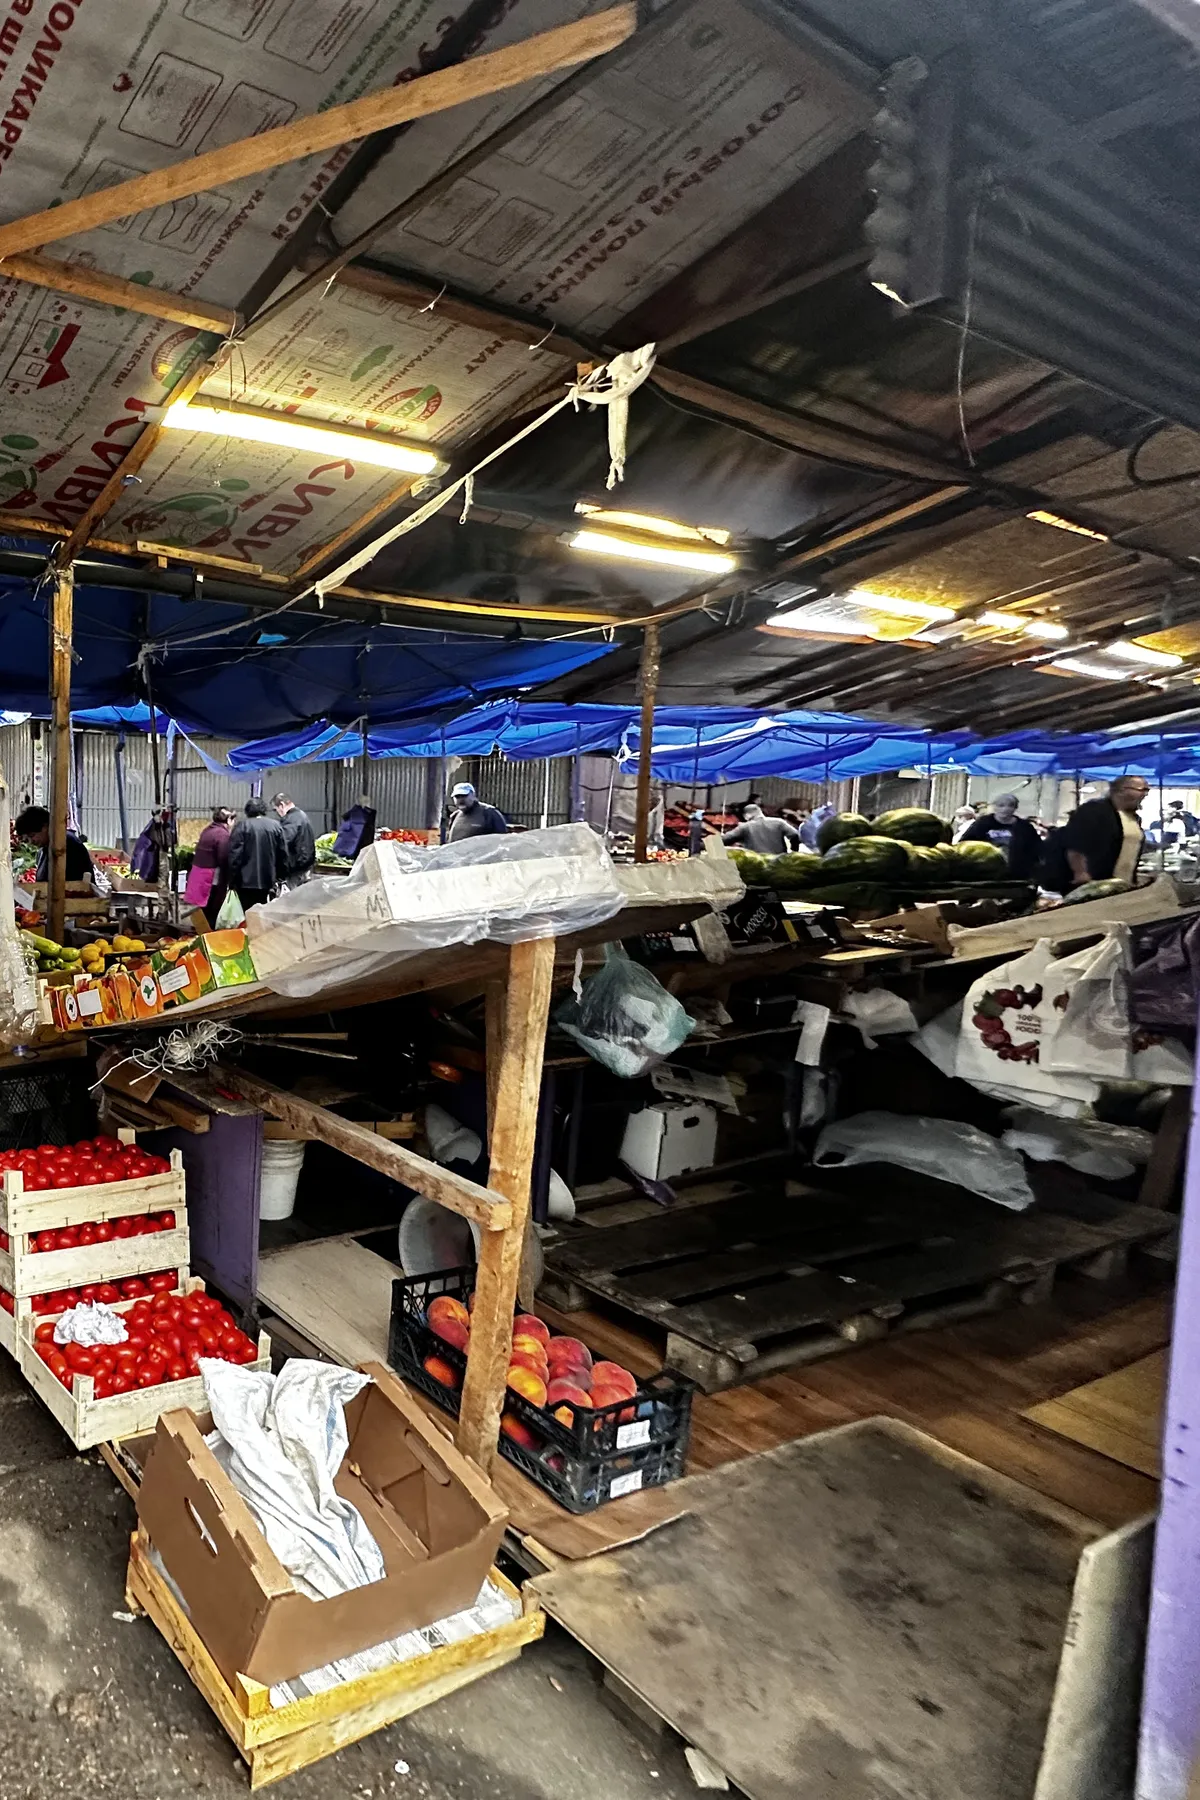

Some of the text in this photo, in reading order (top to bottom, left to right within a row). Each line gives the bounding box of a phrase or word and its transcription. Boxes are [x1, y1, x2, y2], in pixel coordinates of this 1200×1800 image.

[649, 81, 807, 221] СОТОВЫЙ
[195, 187, 265, 274] НАДЕЖНЫЕ
[514, 162, 684, 308] УФ-защито
[109, 330, 157, 391] КАЧЕСТВА!
